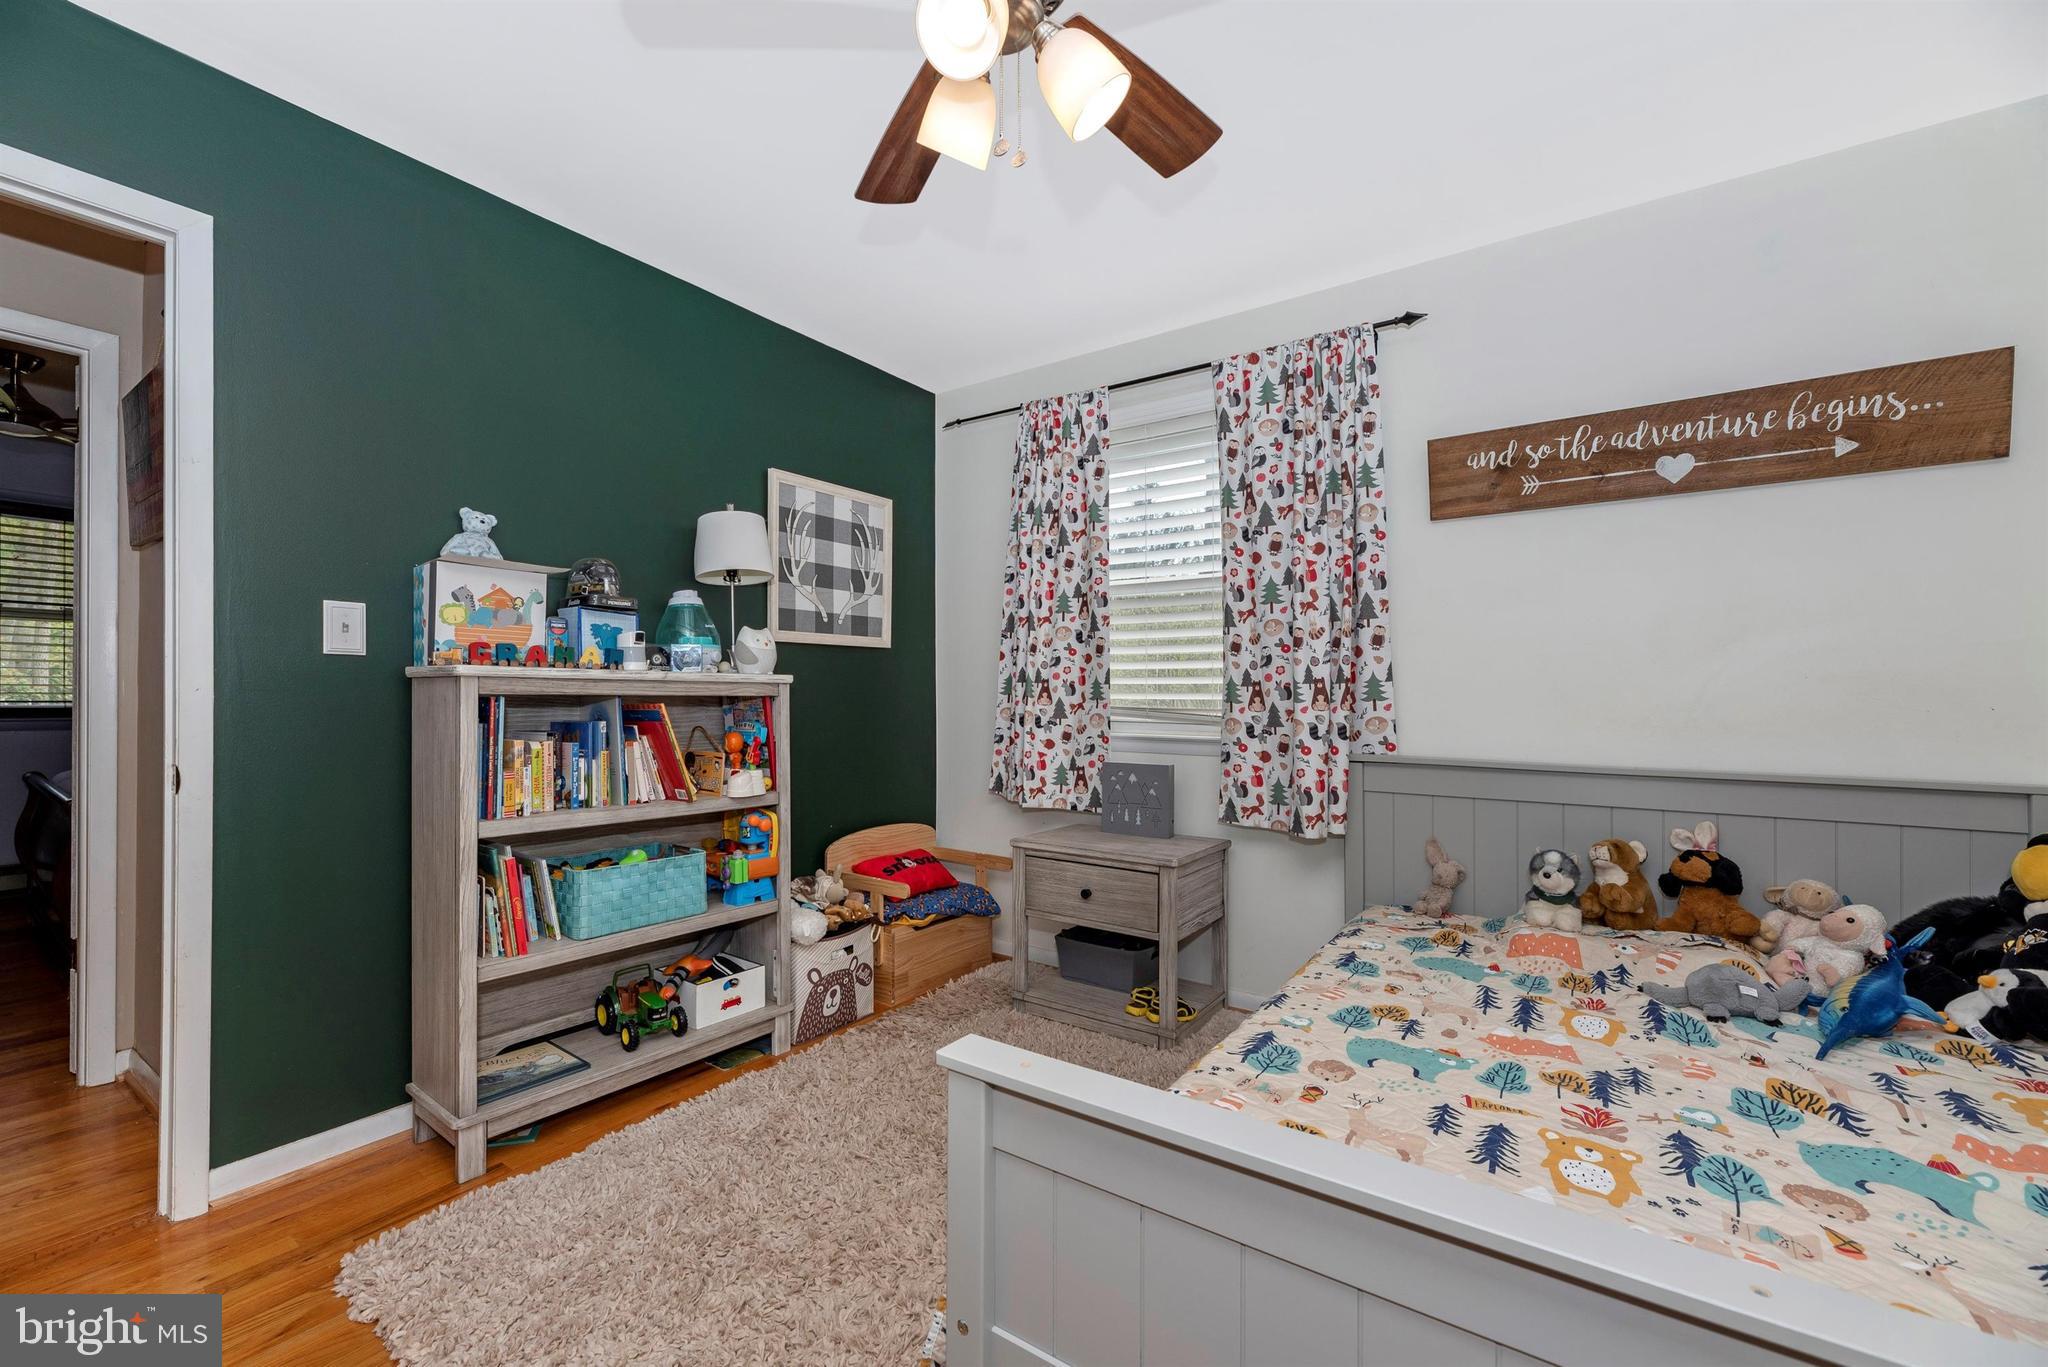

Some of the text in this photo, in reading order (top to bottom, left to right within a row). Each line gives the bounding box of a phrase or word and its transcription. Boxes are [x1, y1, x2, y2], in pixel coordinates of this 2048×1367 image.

[1467, 440, 1521, 469] and
[1525, 444, 1556, 469] so
[1553, 424, 1607, 461] the
[1611, 409, 1782, 450] adventure
